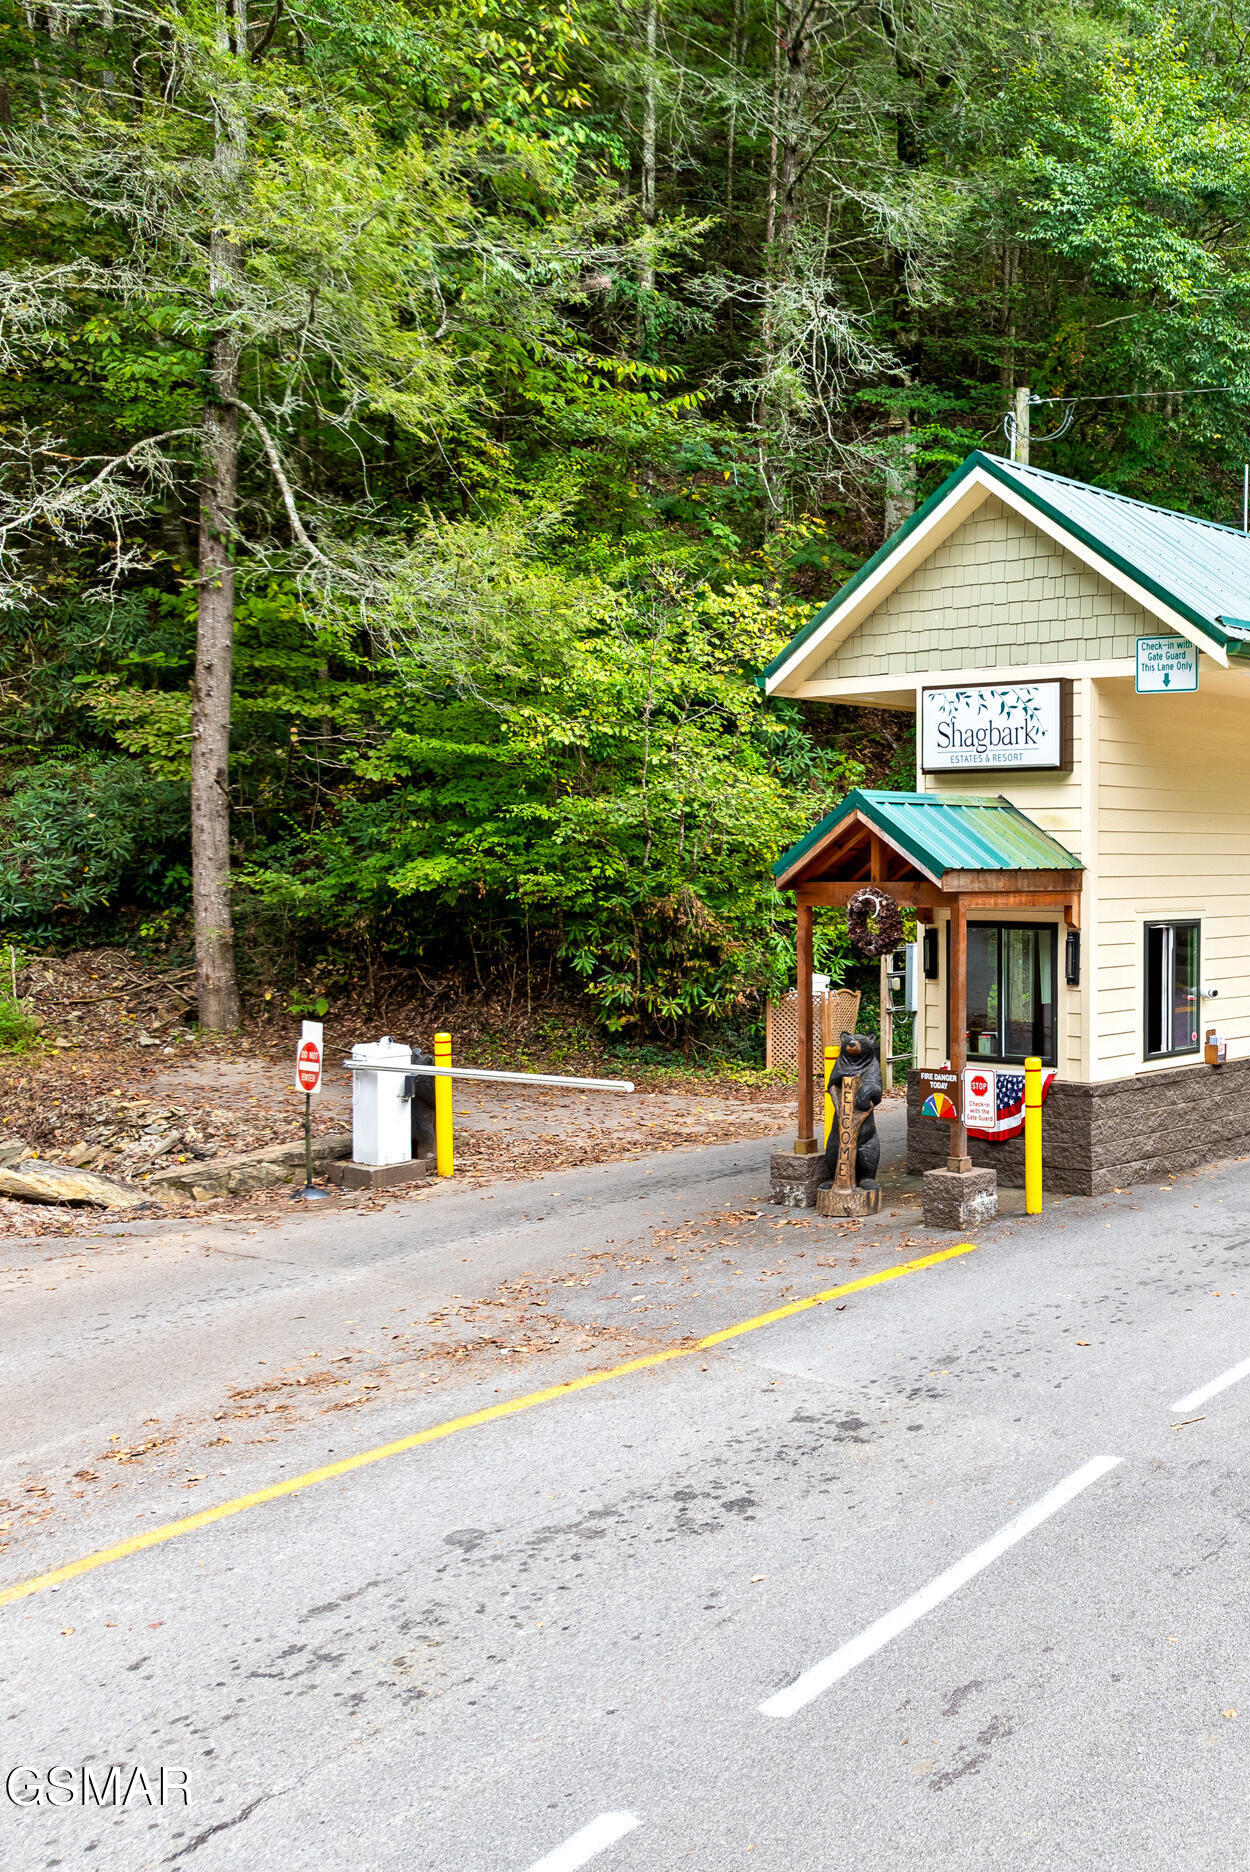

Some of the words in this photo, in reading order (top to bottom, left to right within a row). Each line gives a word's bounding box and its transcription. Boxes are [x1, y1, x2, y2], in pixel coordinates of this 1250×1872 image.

[1141, 640, 1174, 651] Check-in
[1176, 639, 1193, 649] with
[1147, 652, 1163, 661] Gate
[1165, 651, 1186, 660] Guard
[1141, 663, 1155, 672] This
[1157, 662, 1174, 671] Lane
[1176, 661, 1193, 672] Only
[937, 718, 1038, 753] Shagbark
[950, 754, 983, 764] ESTATES
[985, 753, 990, 763] &
[992, 752, 1023, 763] RESORT
[301, 1050, 308, 1058] DO
[309, 1051, 319, 1060] NOT
[301, 1073, 316, 1083] ENTER
[920, 1072, 934, 1080] FIRE
[934, 1074, 958, 1082] DANGER
[930, 1081, 949, 1090] TODAY
[971, 1082, 988, 1090] STOP
[838, 1079, 852, 1177] WELCOME
